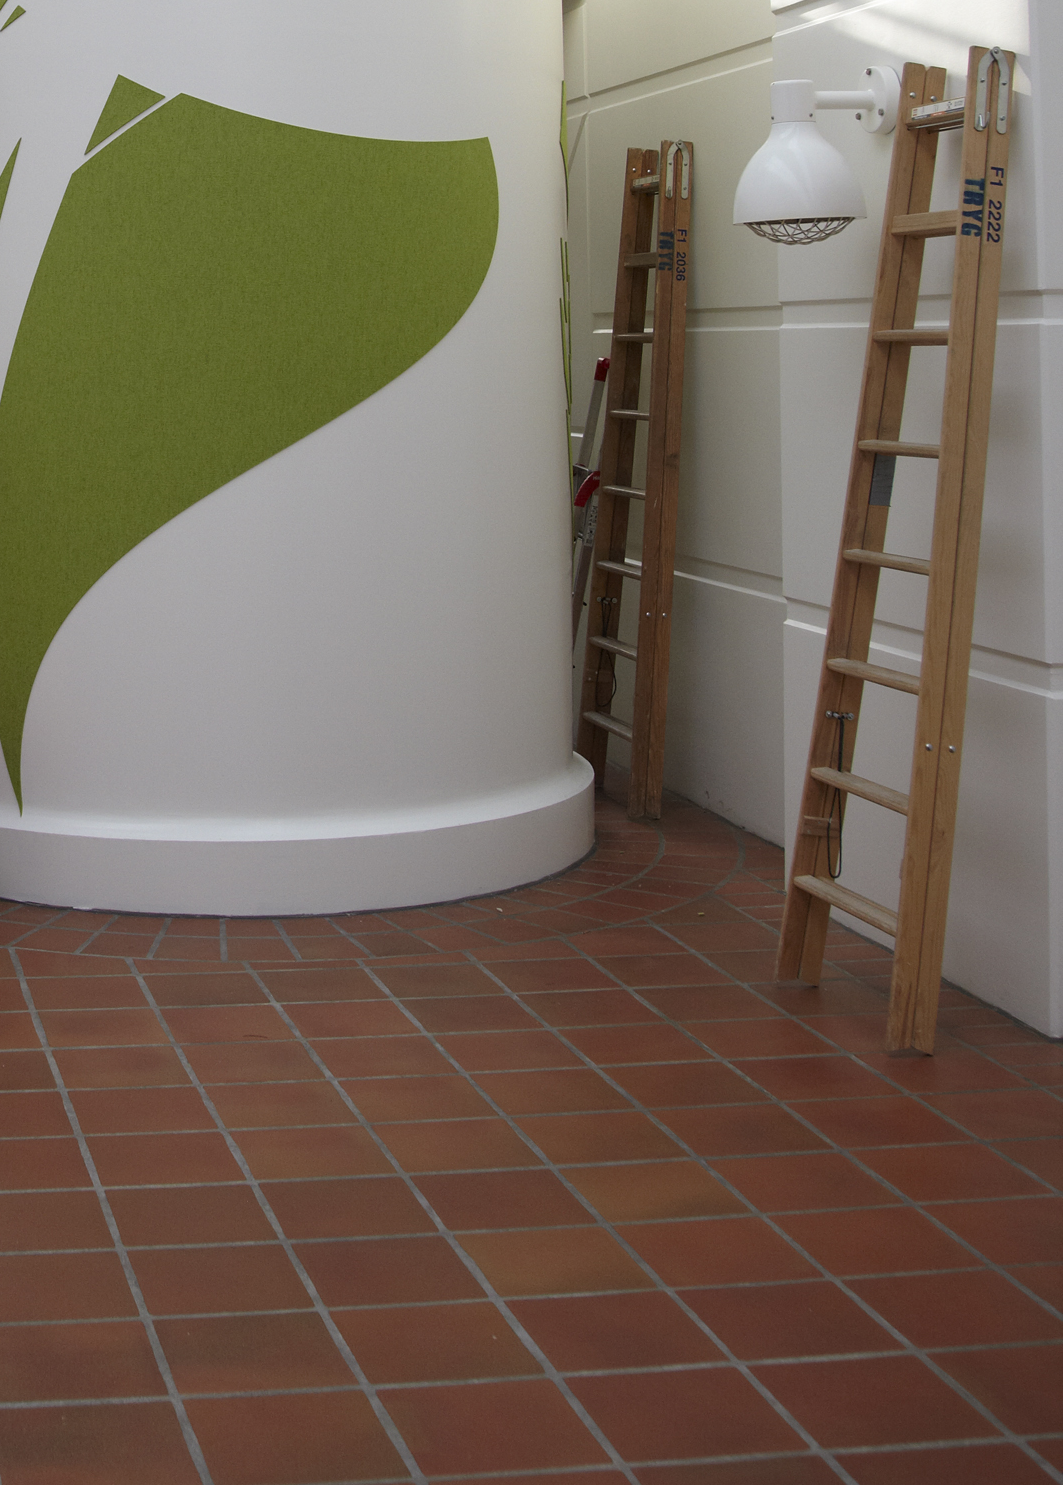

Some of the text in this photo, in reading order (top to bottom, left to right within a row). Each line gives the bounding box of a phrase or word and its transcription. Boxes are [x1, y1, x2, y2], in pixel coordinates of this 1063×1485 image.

[961, 178, 985, 238] TRYG
[986, 166, 1004, 243] F1 2222
[658, 231, 674, 271] TRYG
[675, 228, 687, 282] F1 2036
